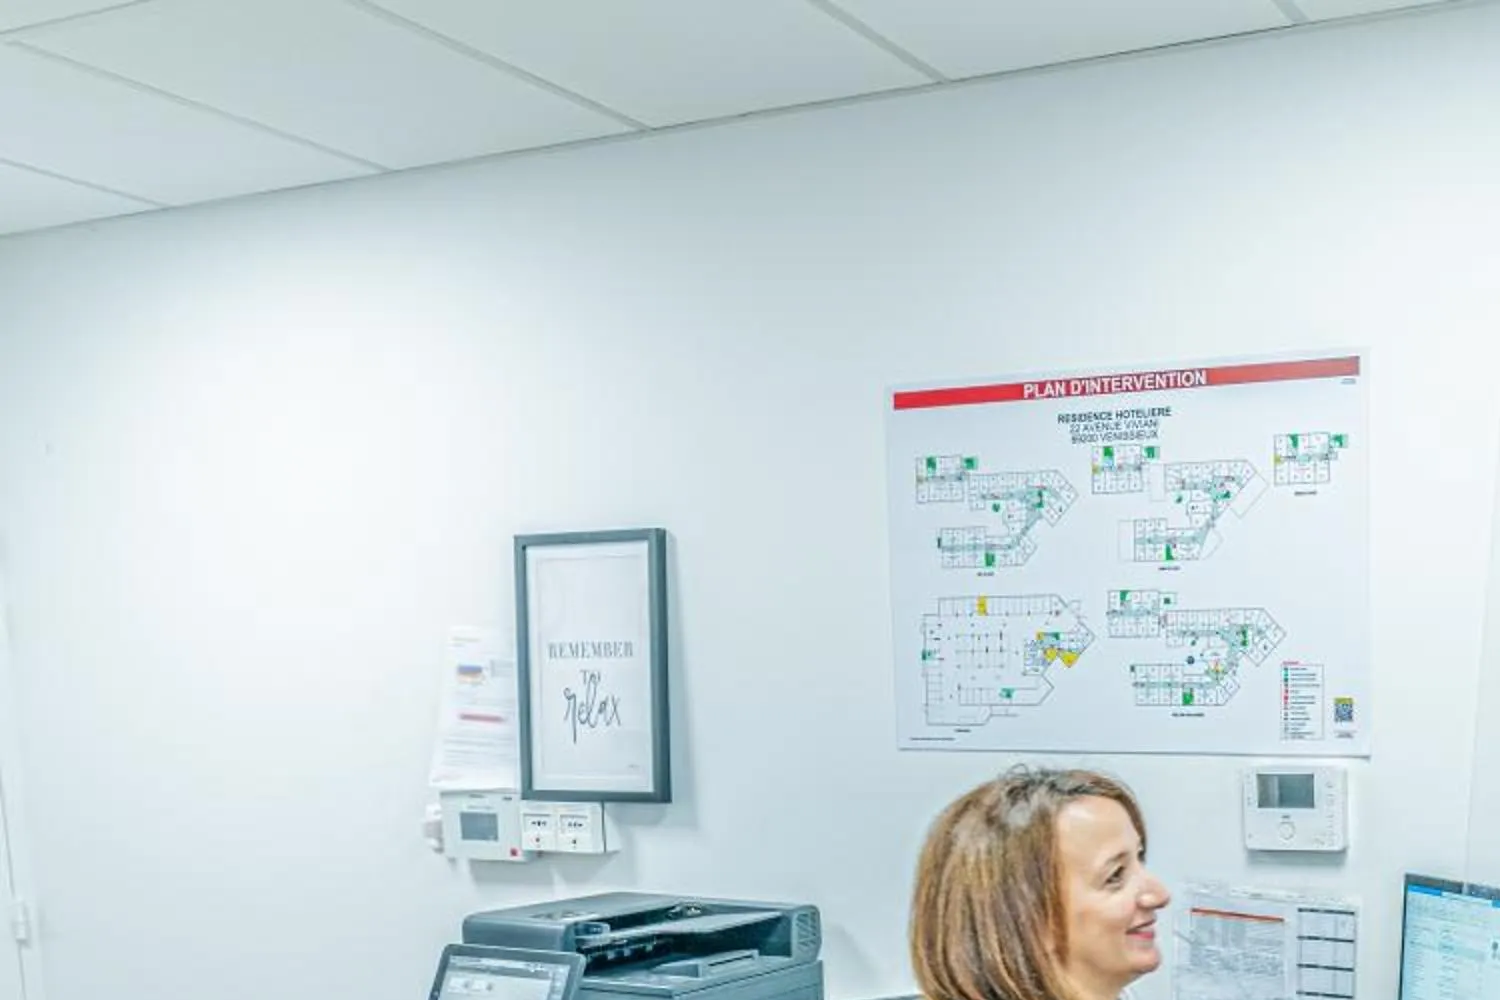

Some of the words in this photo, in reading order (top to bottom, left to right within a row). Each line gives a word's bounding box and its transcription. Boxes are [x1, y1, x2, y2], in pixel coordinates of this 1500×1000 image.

[1023, 382, 1066, 399] PLAN
[1070, 370, 1207, 396] D'INTERVENTION
[1057, 411, 1113, 425] RESIDENCE
[1116, 406, 1172, 420] HOTELIERE
[548, 640, 634, 659] REMEMBER
[563, 673, 622, 745] relax
